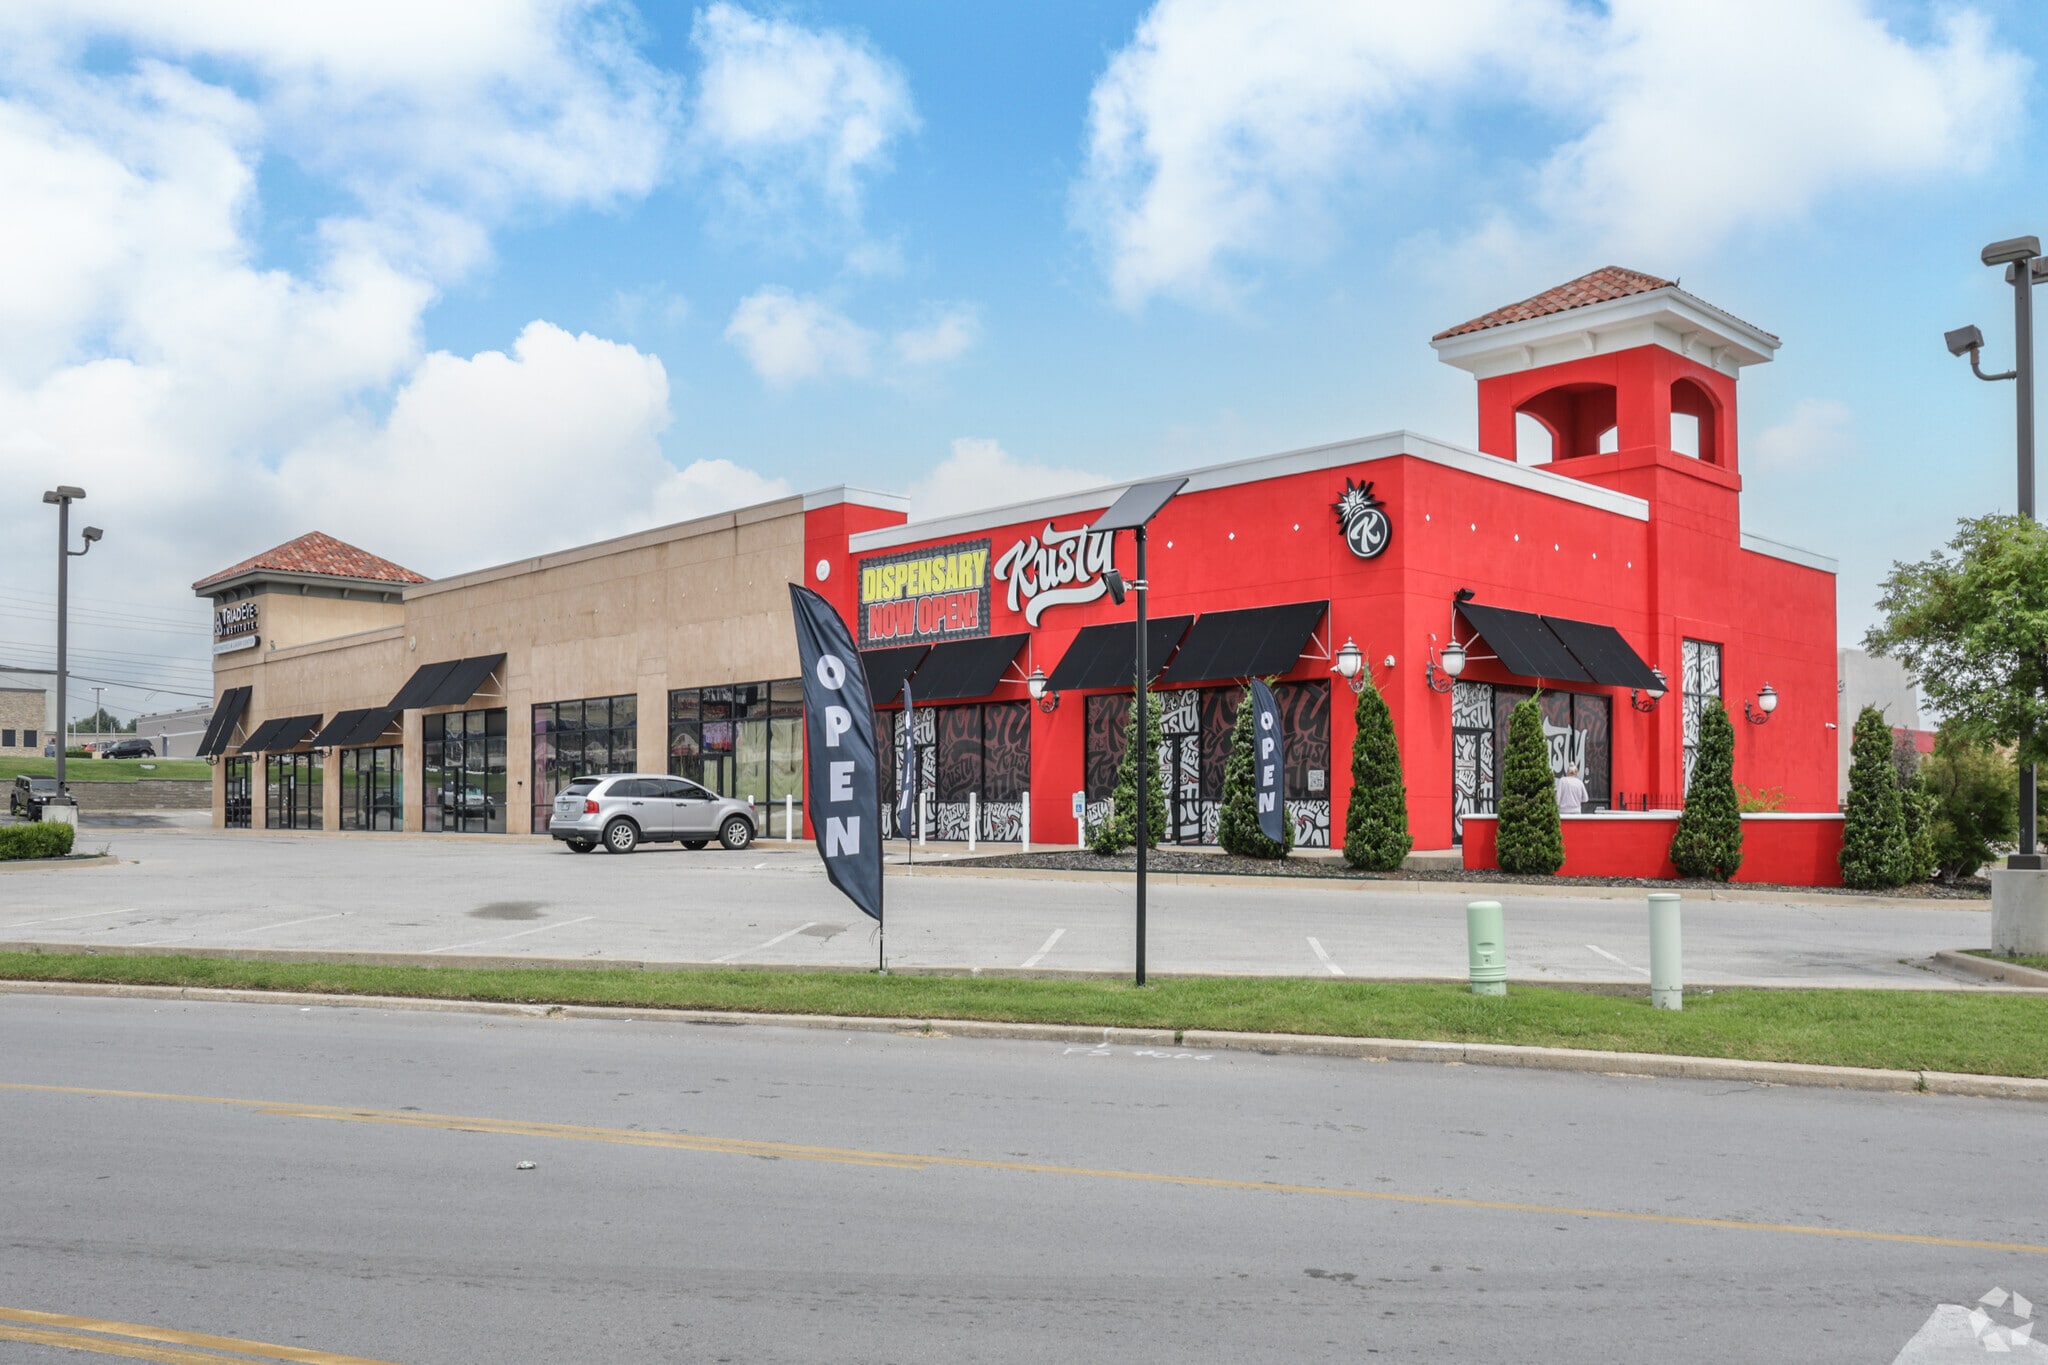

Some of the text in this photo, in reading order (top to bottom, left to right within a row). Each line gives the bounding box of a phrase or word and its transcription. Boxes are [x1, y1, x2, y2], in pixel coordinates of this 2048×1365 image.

[1350, 513, 1380, 553] K
[862, 548, 988, 604] DISPENSARY
[223, 621, 255, 636] INSTITUTE
[868, 590, 980, 640] NOW OPEN!
[816, 653, 860, 859] OPEN
[1258, 710, 1276, 814] OPEN
